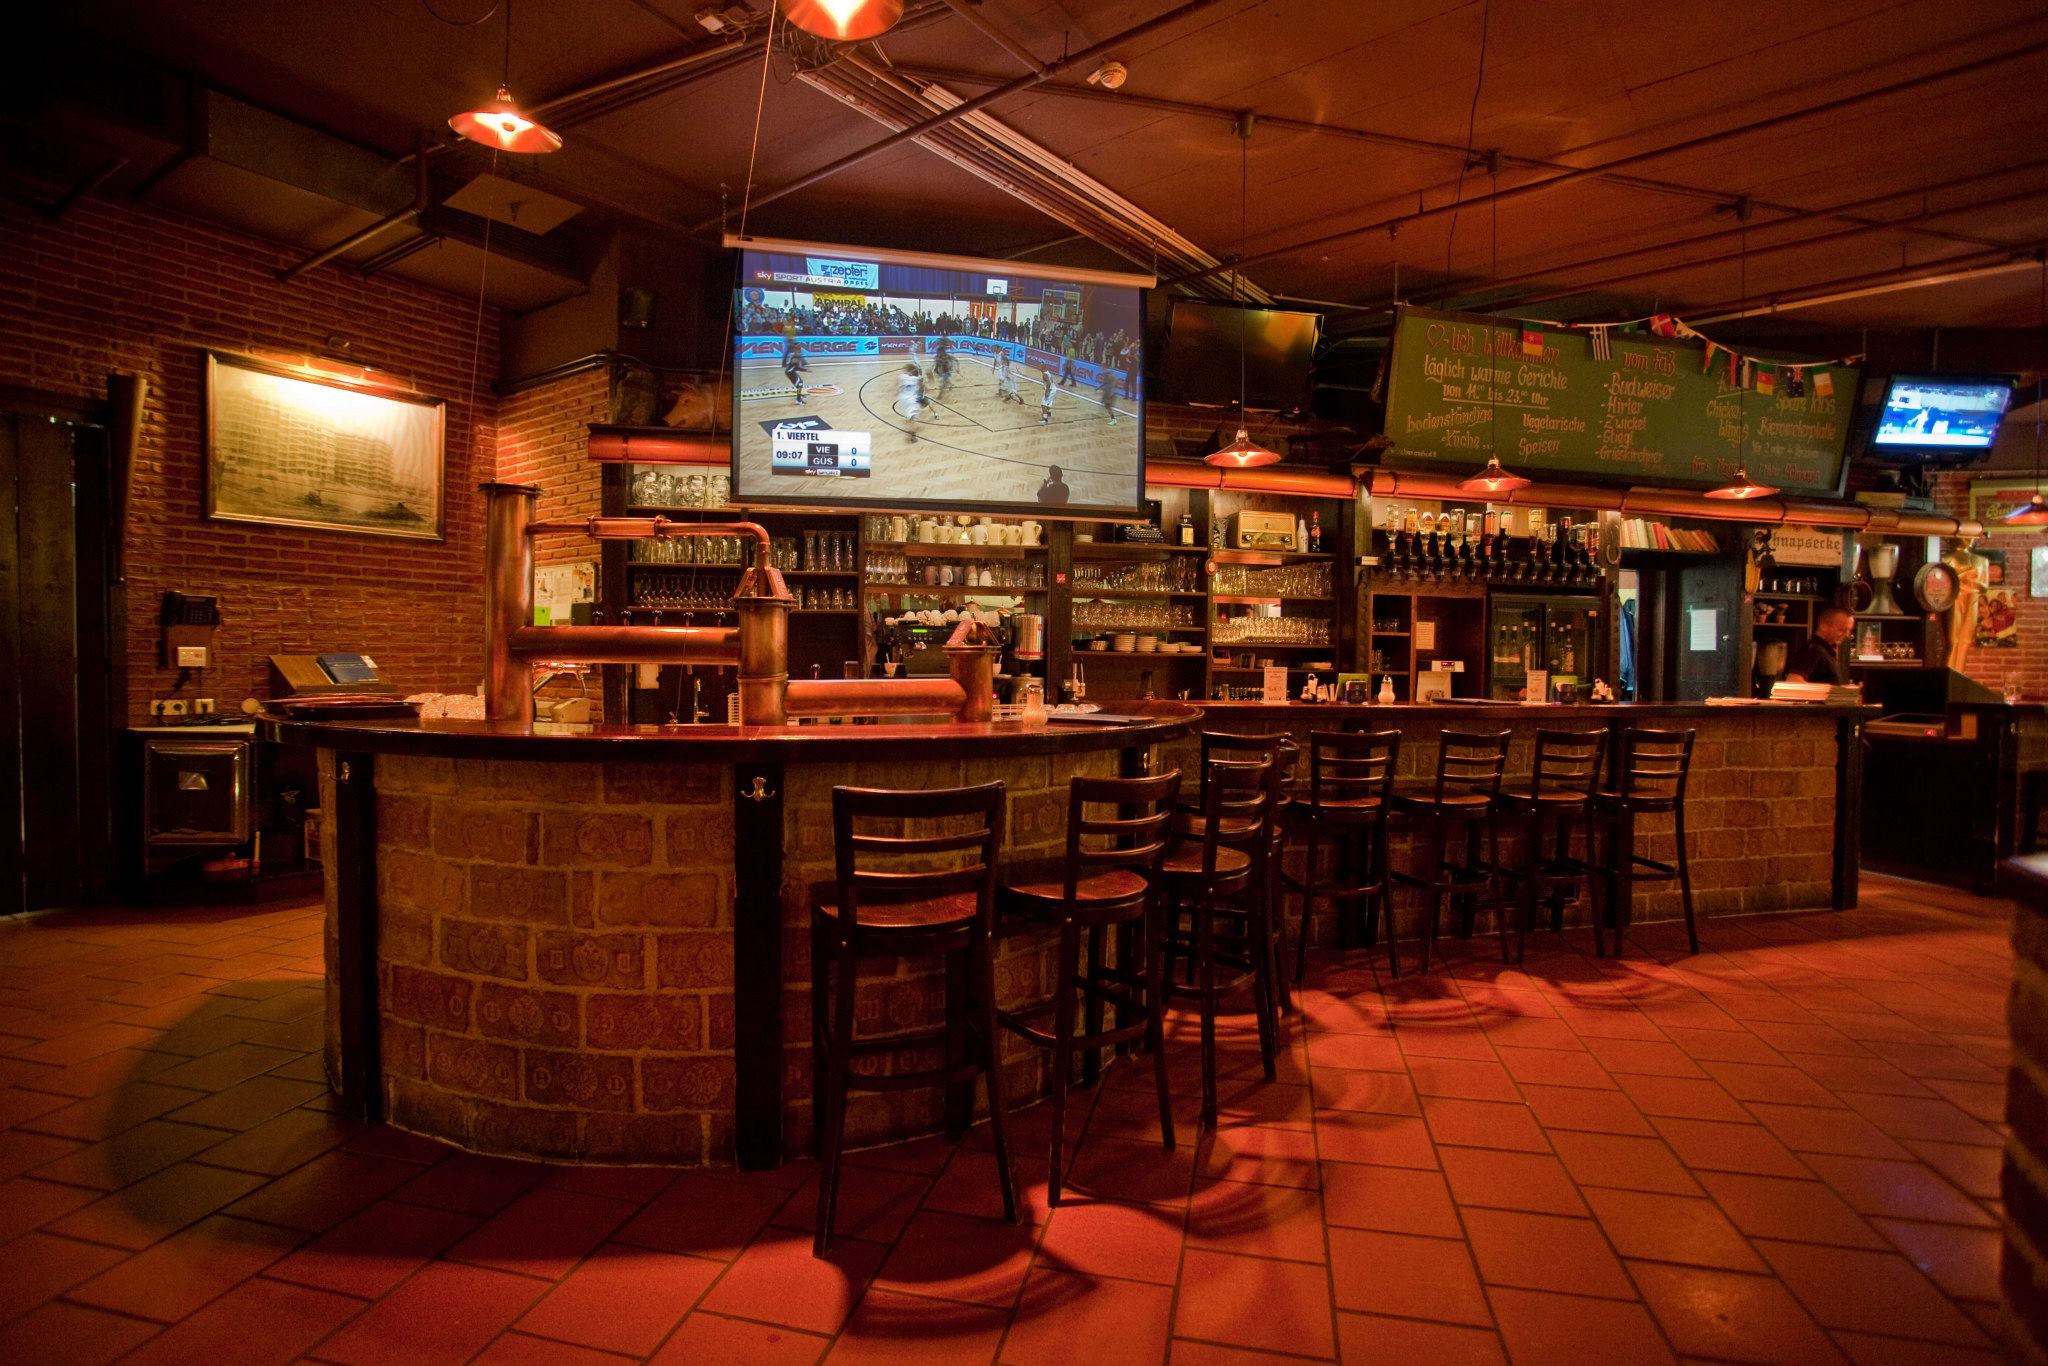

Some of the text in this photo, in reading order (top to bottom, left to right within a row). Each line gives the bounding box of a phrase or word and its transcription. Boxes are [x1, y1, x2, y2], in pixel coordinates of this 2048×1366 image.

[757, 271, 771, 280] sky
[775, 273, 803, 281] SPORT
[805, 276, 842, 285] AUSTRIA
[831, 264, 868, 279] zepter
[815, 297, 864, 309] ADMIRAL
[790, 340, 858, 353] NERGIE
[1424, 354, 1568, 391] täglich warme Gerichte
[1443, 384, 1461, 398] von
[1488, 387, 1504, 402] bis
[1531, 392, 1549, 407] Uhr
[787, 432, 820, 441] VIERTEL
[776, 451, 803, 459] 09:07
[816, 446, 857, 455] VIE 0
[1519, 438, 1560, 463] Speisen
[813, 456, 857, 467] GÜS 0
[1772, 531, 1841, 551] hnapsecke
